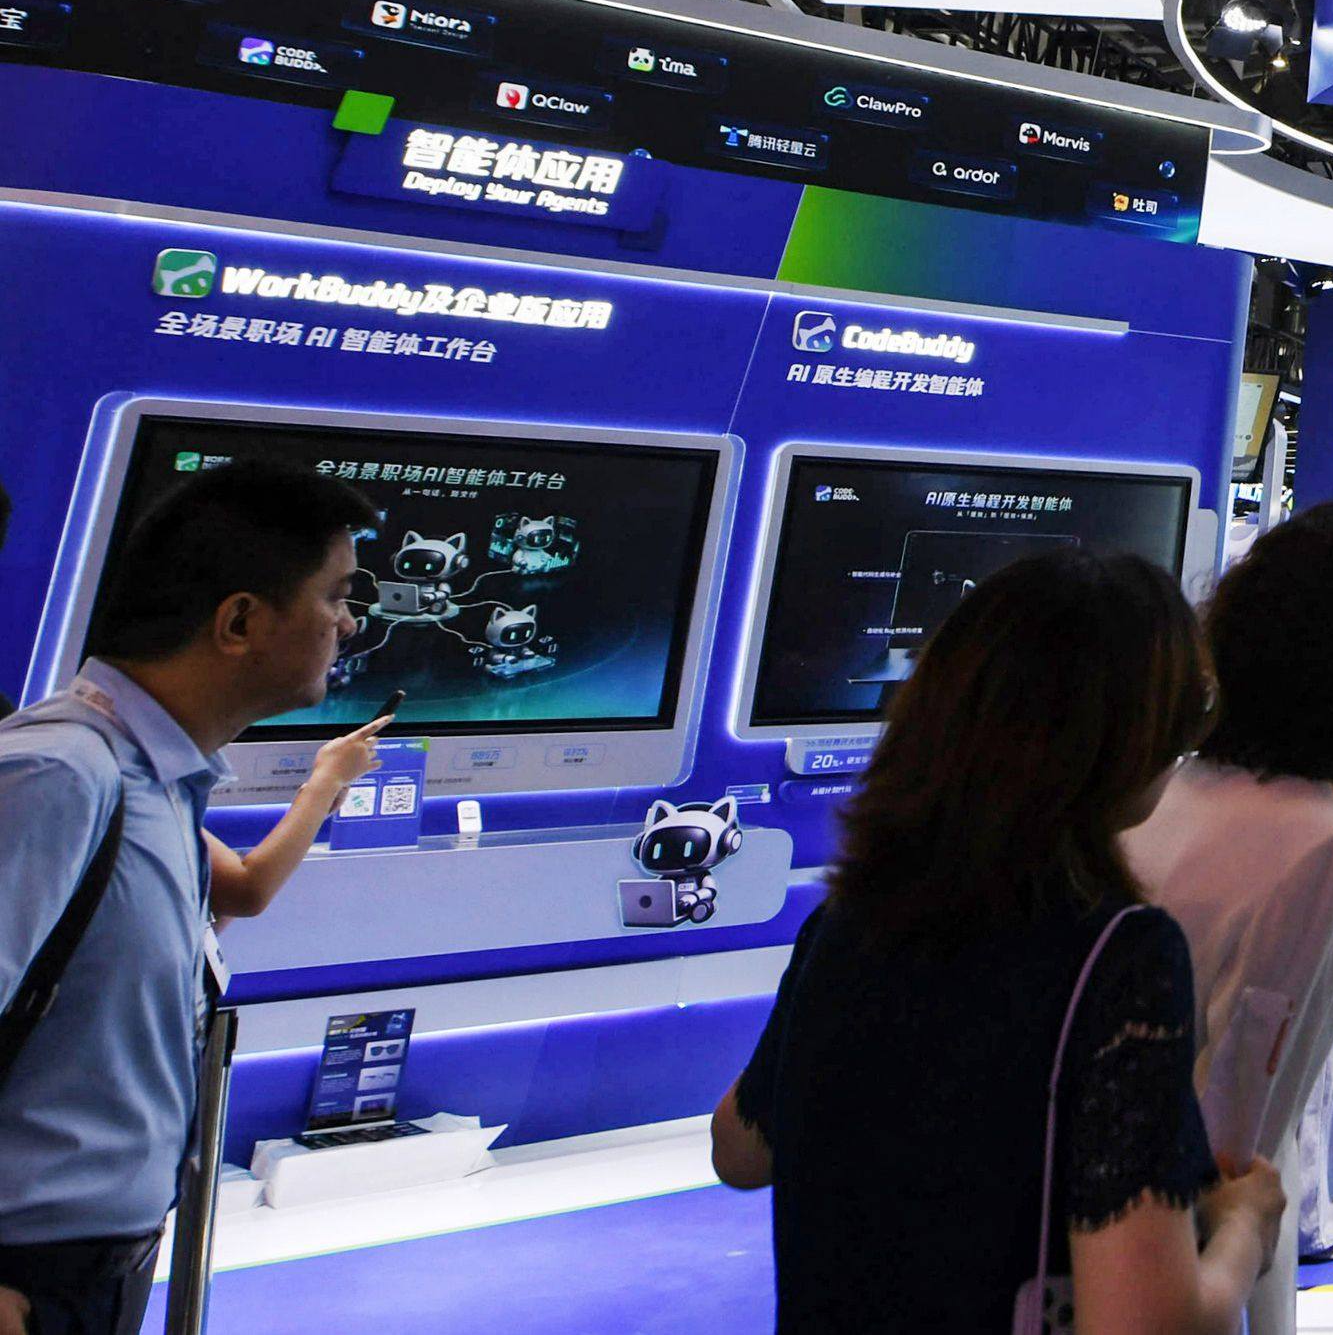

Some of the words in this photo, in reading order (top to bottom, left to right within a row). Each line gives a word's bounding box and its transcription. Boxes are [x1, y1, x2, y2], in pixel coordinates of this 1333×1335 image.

[532, 93, 590, 115] QClaw
[856, 95, 922, 118] ClawPro
[747, 133, 817, 159] 腾讯轻量云
[1043, 130, 1090, 152] Marvis
[403, 128, 624, 195] 智能体应用
[954, 166, 1000, 185] ardot
[402, 171, 482, 201] Deploy
[484, 182, 536, 204] Your
[535, 190, 609, 216] Agents
[1132, 198, 1158, 215] 吐司
[155, 311, 306, 346] 全场景职场
[305, 326, 335, 347] AI
[341, 327, 498, 364] 智能体工作台
[841, 324, 976, 365] CodeBuddy
[786, 364, 810, 383] AI
[812, 366, 984, 398] 原生编程开发智能体
[315, 460, 567, 491] 全场景职场AI智能体工作台
[925, 491, 1073, 512] AI原生编程开发智能体
